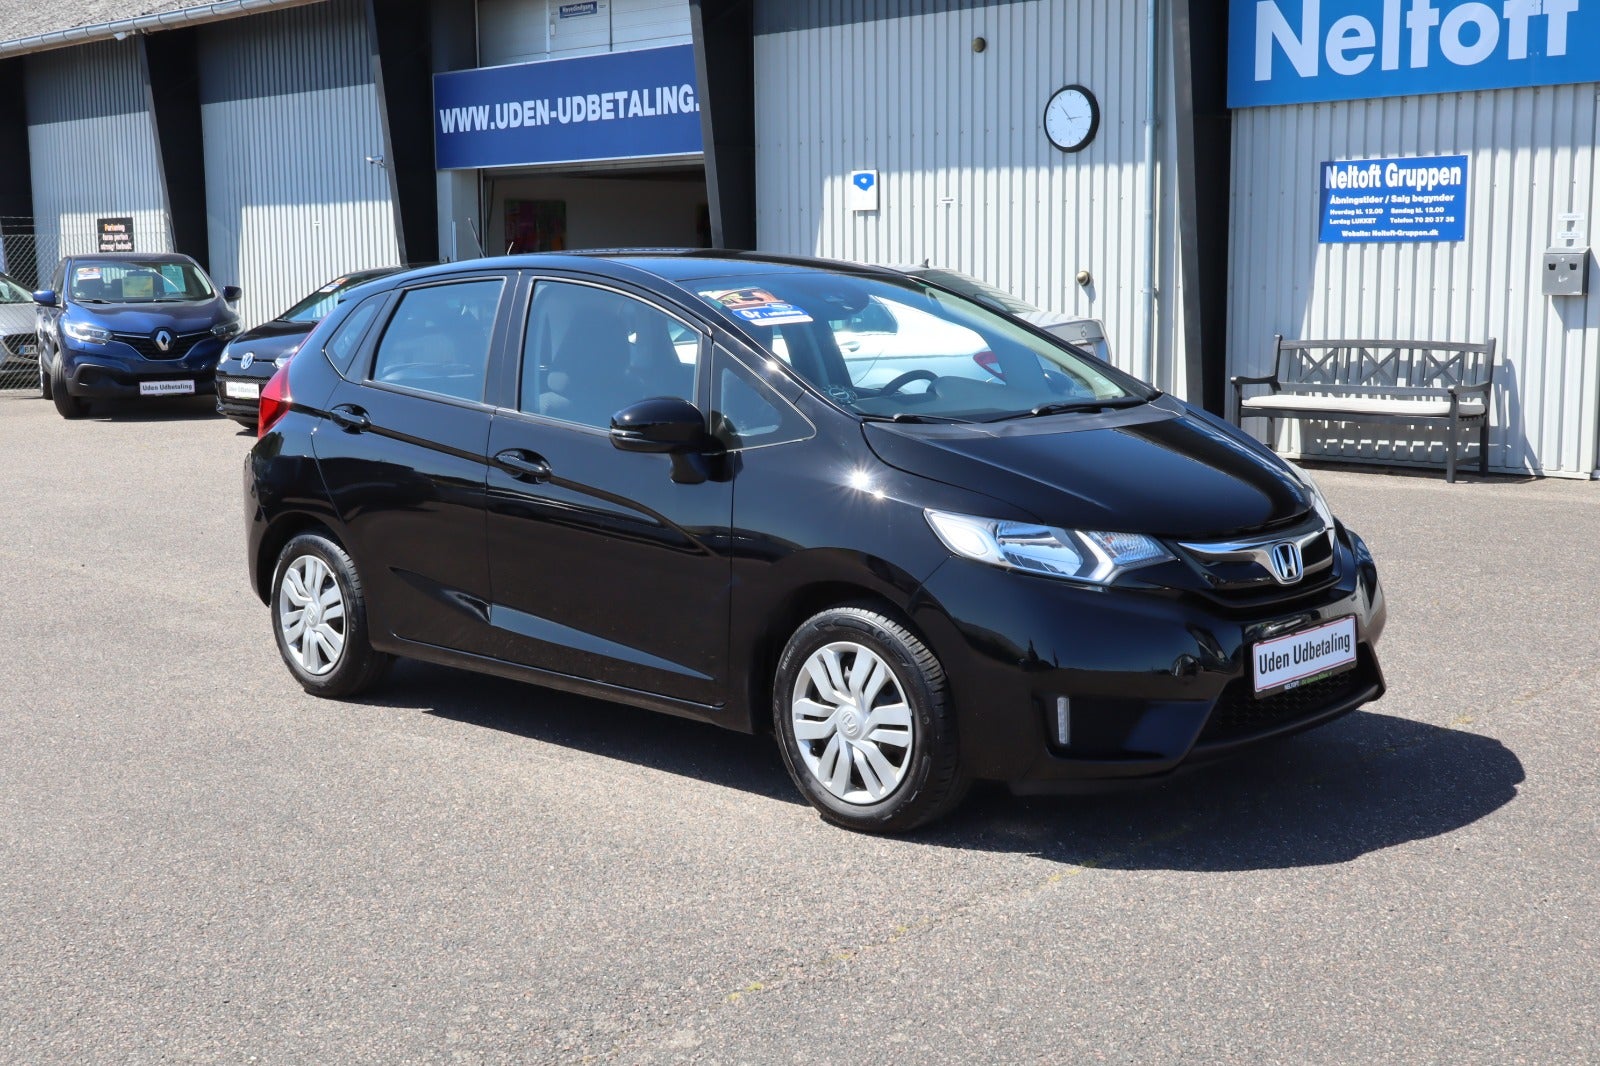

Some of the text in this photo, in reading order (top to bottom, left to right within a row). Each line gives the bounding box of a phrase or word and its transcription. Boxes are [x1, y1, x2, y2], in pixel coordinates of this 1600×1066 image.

[1254, 0, 1580, 82] Neltoft
[439, 84, 700, 134] WWW.UDEN-UDBETALING.
[1325, 162, 1462, 192] Neltoft Gruppen
[1329, 195, 1384, 205] Åbningstider
[1391, 194, 1411, 204] Salg
[1412, 193, 1455, 204] begynder
[1351, 217, 1377, 225] LUKKET
[1364, 207, 1384, 215] 12.00
[160, 383, 193, 391] Udbetaling
[1259, 633, 1351, 675] Uden Udbetaling
